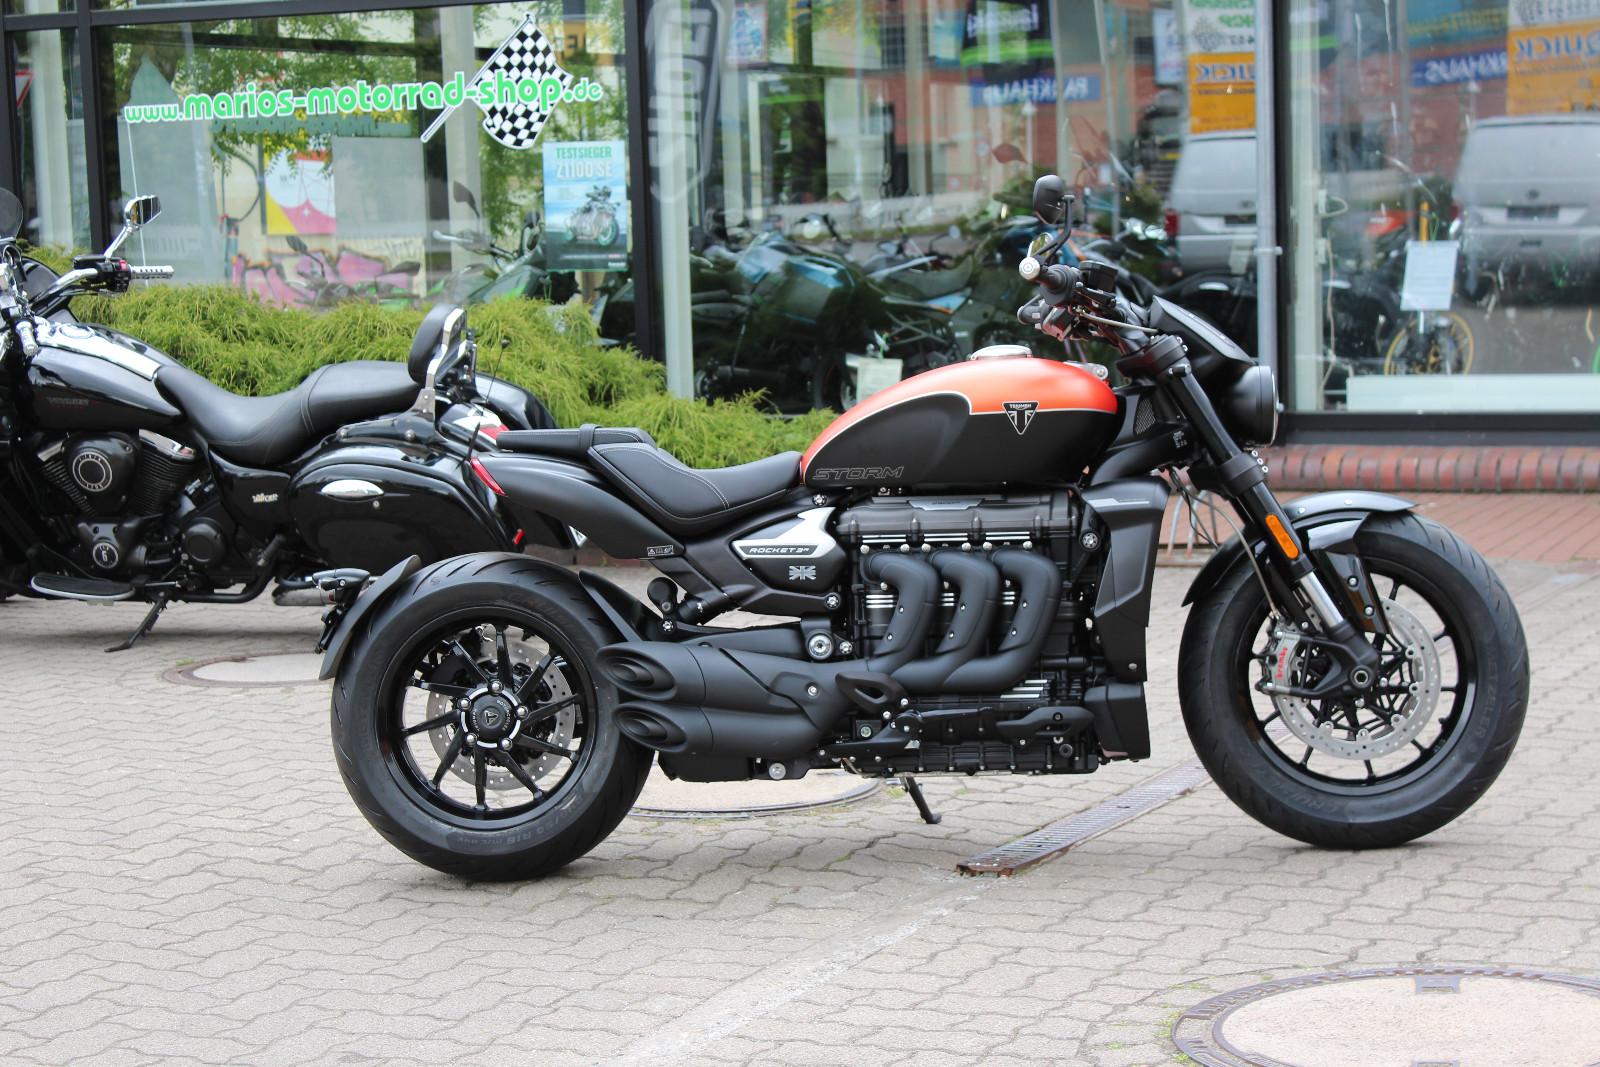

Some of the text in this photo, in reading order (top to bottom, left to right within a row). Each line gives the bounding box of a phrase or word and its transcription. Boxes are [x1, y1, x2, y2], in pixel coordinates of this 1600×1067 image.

[124, 70, 603, 125] www.marios-motorrad-shop.de
[556, 146, 613, 159] TESTSIEGER
[813, 466, 905, 480] STORM
